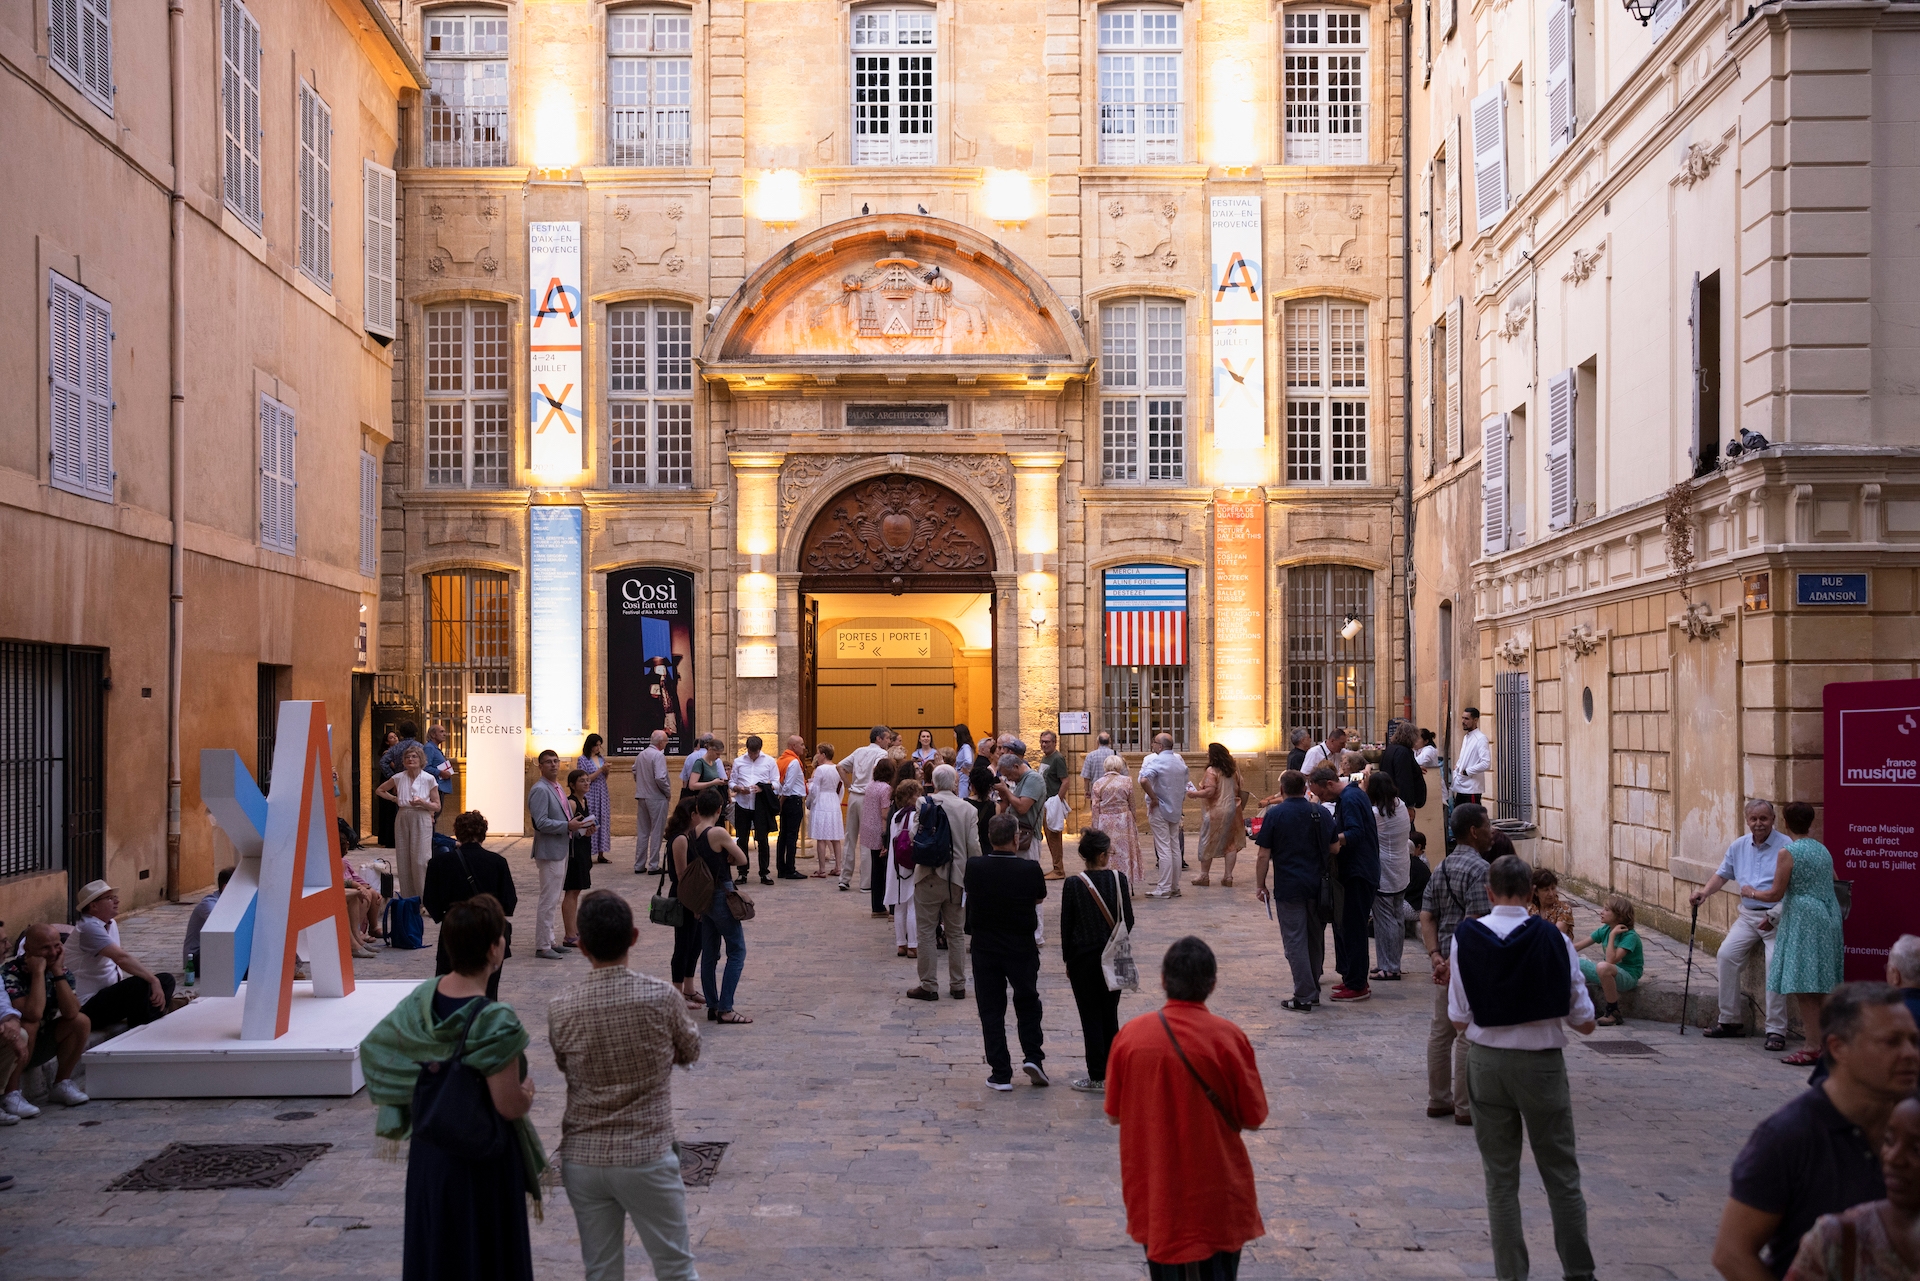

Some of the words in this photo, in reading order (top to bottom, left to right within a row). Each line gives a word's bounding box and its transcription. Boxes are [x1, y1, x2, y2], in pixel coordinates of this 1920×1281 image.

[532, 224, 572, 232] FESTIVAL
[1212, 220, 1258, 228] PROVENCE
[532, 246, 578, 254] PROVENCE
[848, 412, 874, 420] PALAIS
[1822, 576, 1843, 586] RUE
[622, 577, 677, 601] Così
[1809, 592, 1856, 600] ADANSON
[622, 601, 640, 609] Così
[642, 601, 656, 609] fan
[839, 632, 877, 641] PORTES
[890, 632, 921, 641] PORTE
[924, 632, 928, 640] 1
[839, 642, 845, 650] 2
[859, 642, 865, 650] 3
[471, 705, 492, 714] BAR
[471, 716, 492, 724] DES
[471, 724, 522, 734] MÉCÈNES
[1886, 758, 1917, 767] france
[1848, 765, 1917, 782] musique
[1848, 823, 1877, 833] France
[1879, 824, 1914, 835] Musique
[1875, 836, 1900, 845] direct
[1844, 848, 1918, 858] d'Aix-en-Provence
[1846, 860, 1856, 868] du
[1859, 860, 1867, 868] 10
[1869, 861, 1879, 869] au
[1882, 861, 1890, 869] 15
[1892, 861, 1916, 871] juillet
